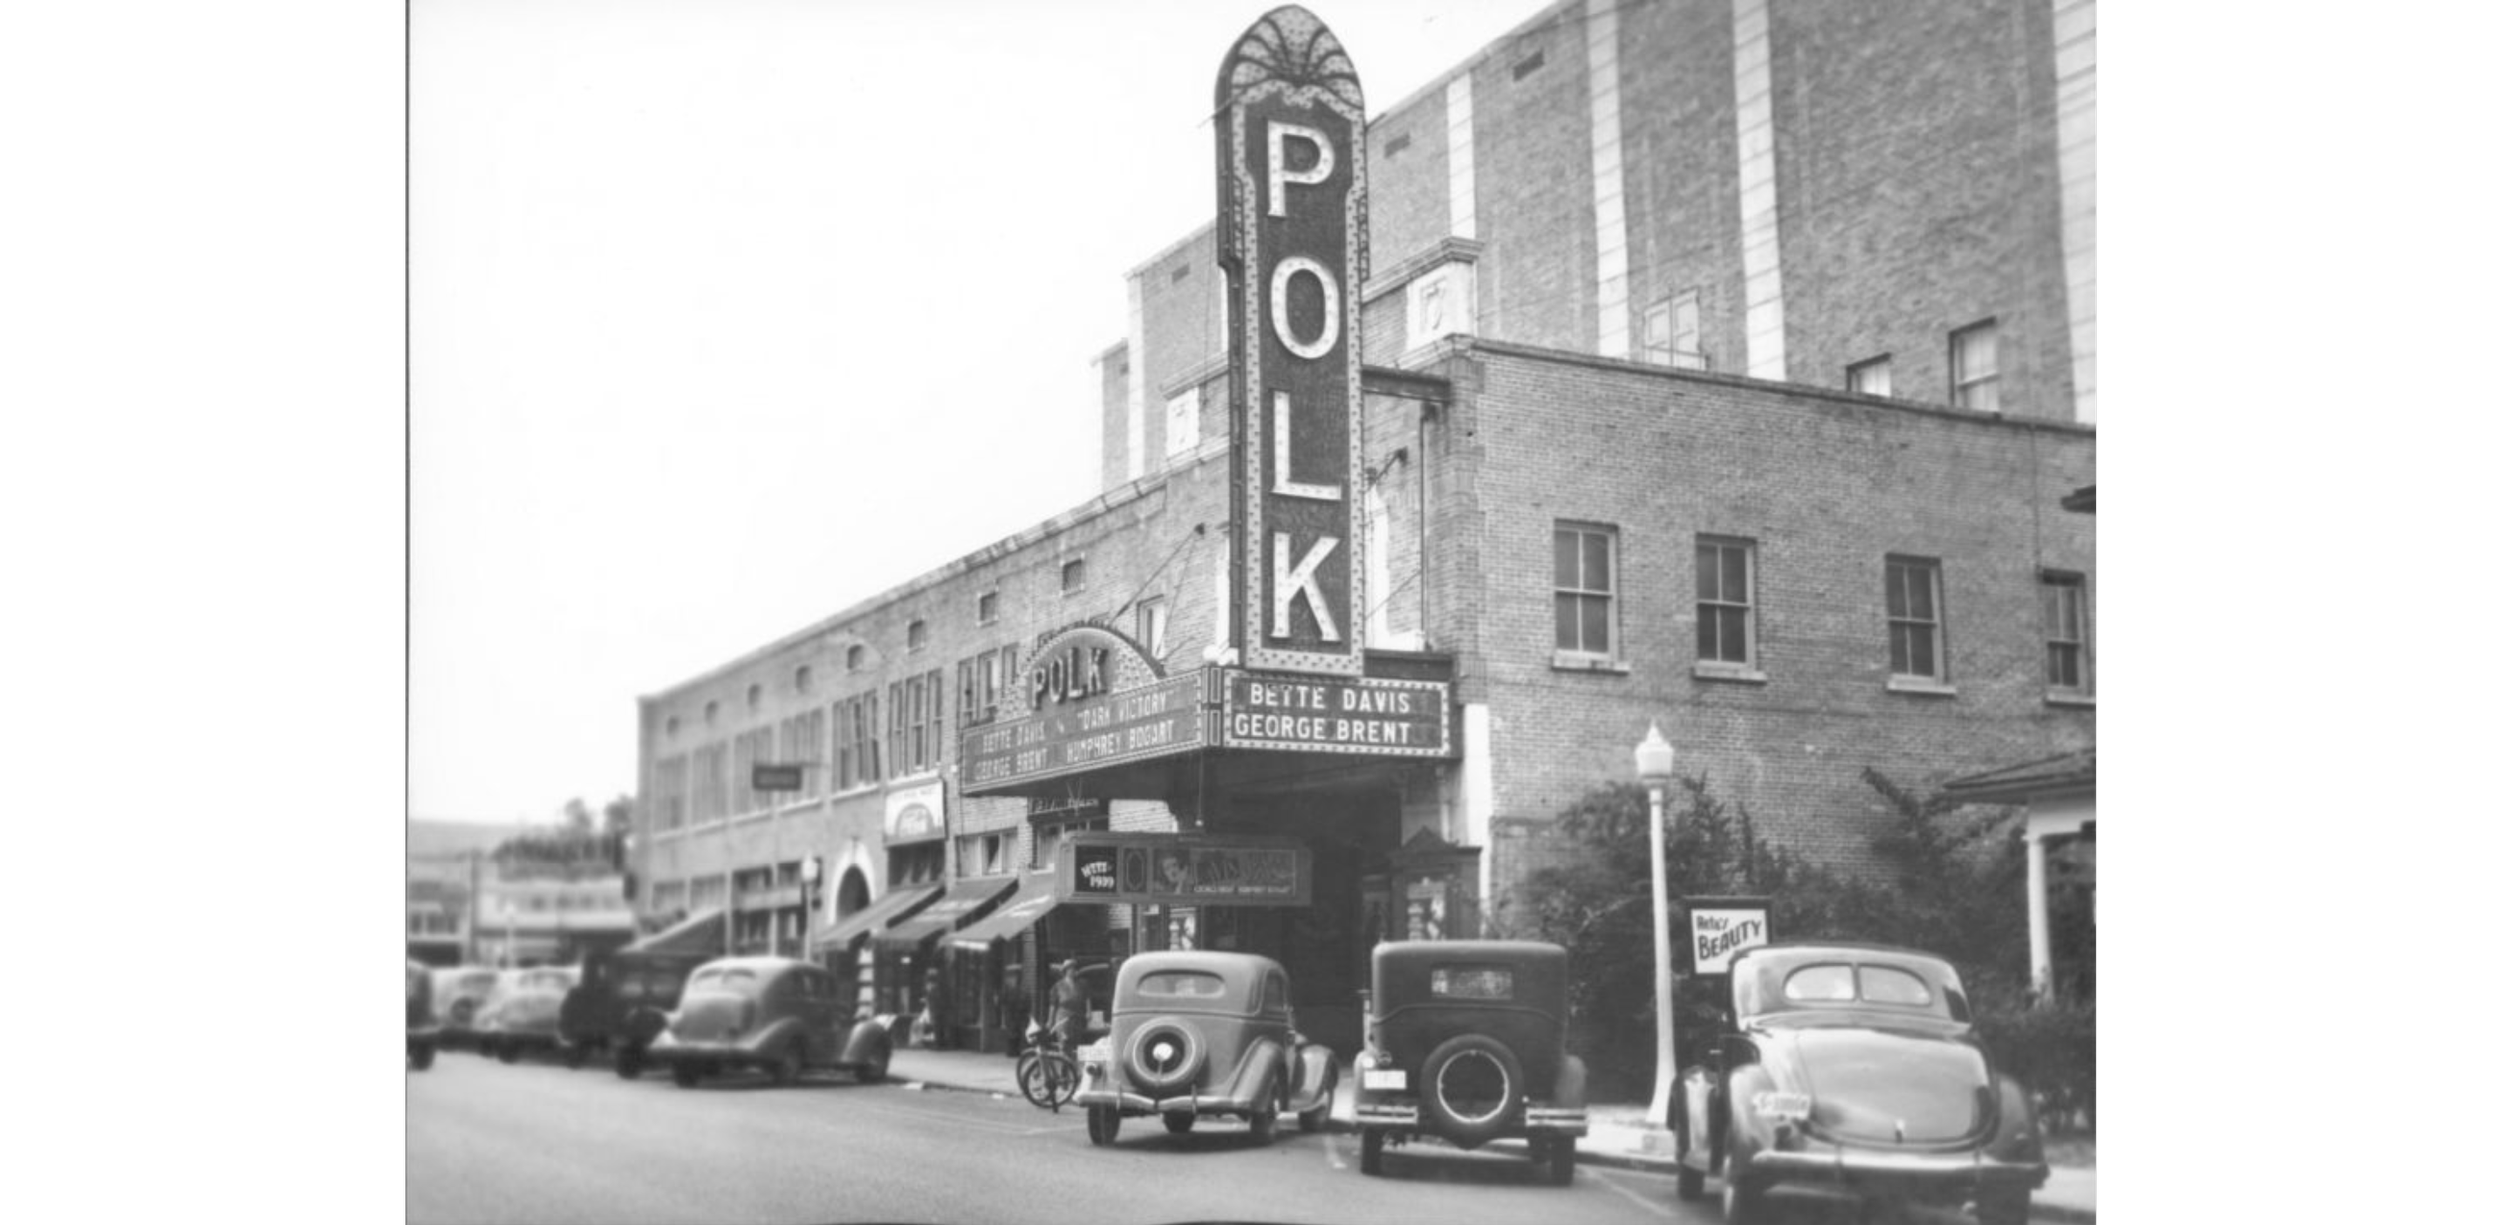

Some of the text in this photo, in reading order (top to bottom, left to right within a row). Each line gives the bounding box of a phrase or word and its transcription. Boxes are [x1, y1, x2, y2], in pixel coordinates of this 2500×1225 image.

[1266, 119, 1342, 643] POLK
[1031, 648, 1106, 709] POLK
[1250, 682, 1411, 714] BETTE DAVIS
[1016, 721, 1046, 747] DAVIS
[1016, 748, 1048, 773] BRENT
[1066, 731, 1122, 763] HUMPHREY
[1129, 719, 1174, 750] BOGART
[1234, 713, 1411, 744] GEORGE BRENT
[1698, 919, 1762, 961] BEAUTY
